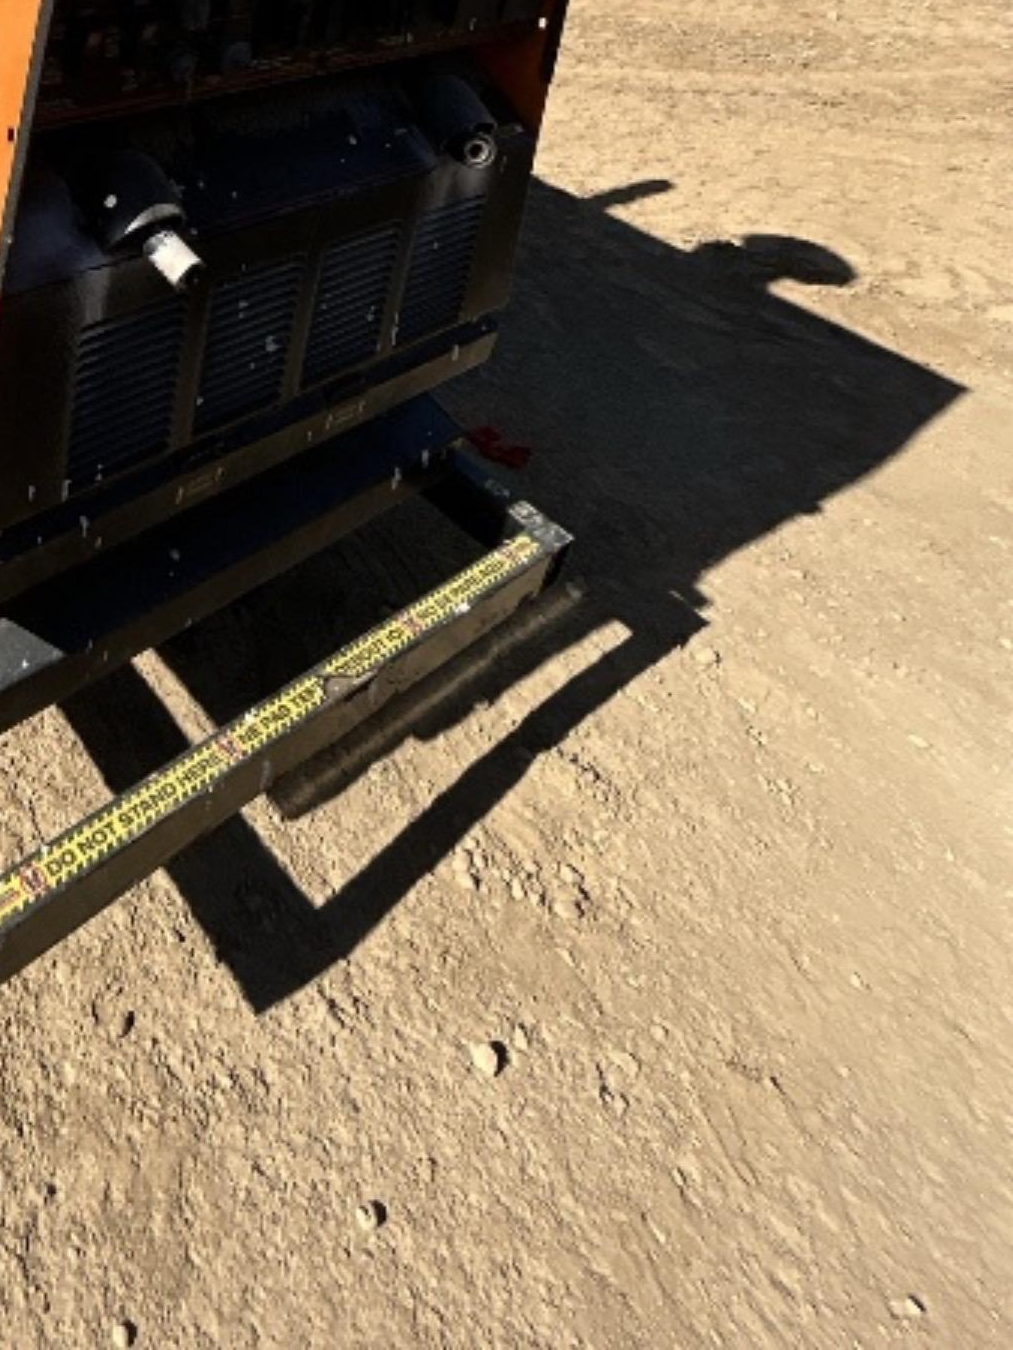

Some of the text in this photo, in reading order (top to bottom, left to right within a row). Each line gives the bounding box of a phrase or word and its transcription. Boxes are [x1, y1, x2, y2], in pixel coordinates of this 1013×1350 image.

[45, 850, 76, 877] DO
[79, 821, 119, 856] NOT
[118, 784, 177, 828] STAND
